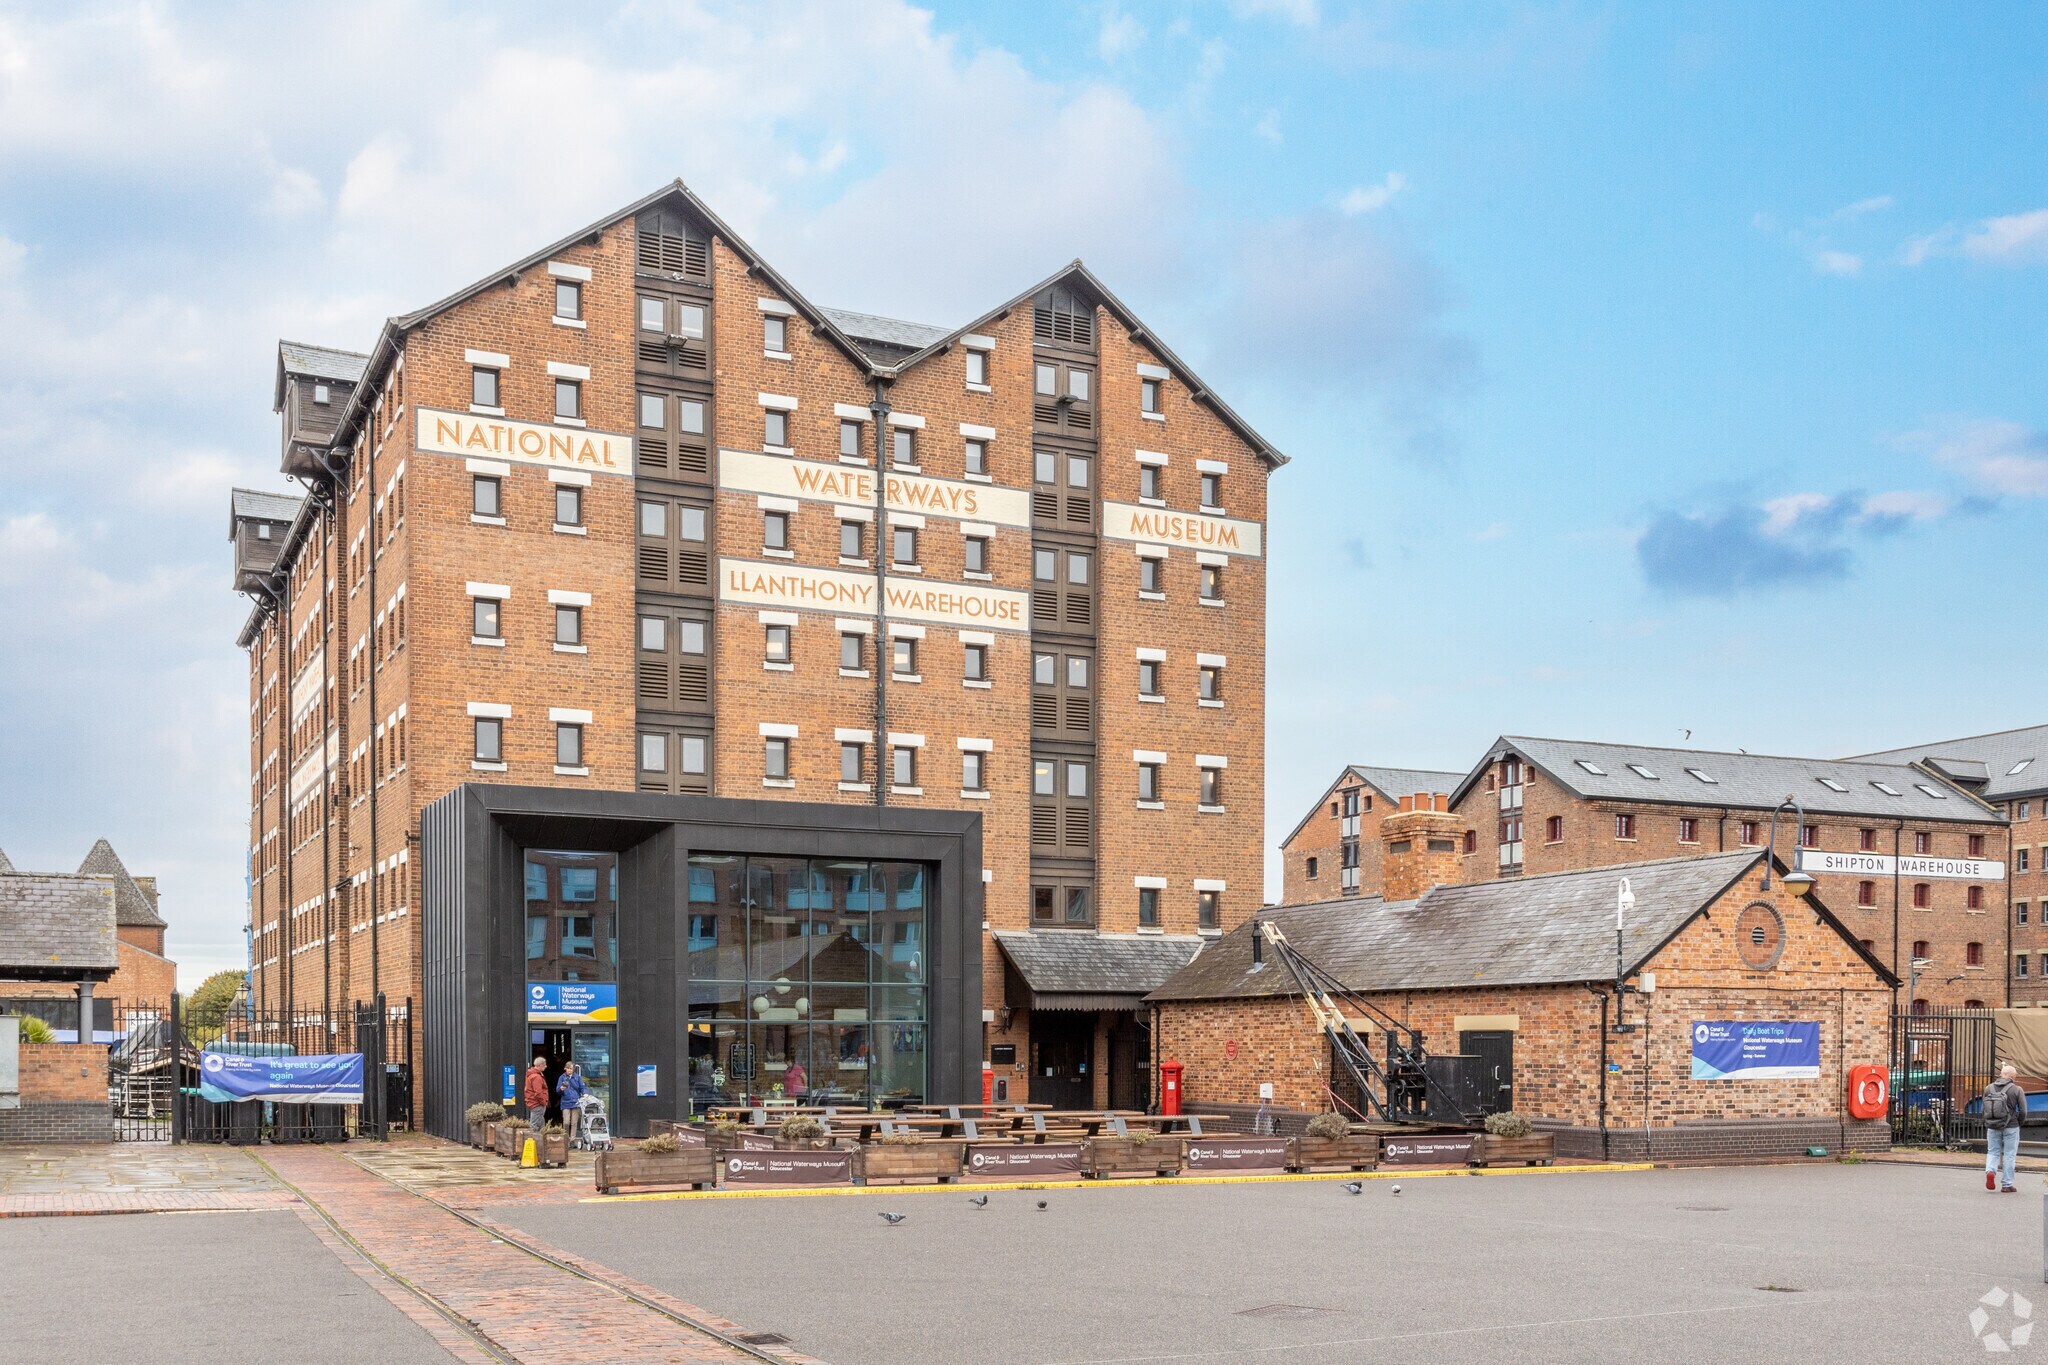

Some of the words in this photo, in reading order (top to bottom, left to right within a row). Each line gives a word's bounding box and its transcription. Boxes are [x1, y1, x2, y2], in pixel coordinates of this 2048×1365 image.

[437, 417, 616, 467] NATIONAL
[793, 465, 979, 515] WATERWAYS
[1130, 511, 1239, 548] MUSEUM
[730, 570, 873, 604] LLANTHONY
[885, 586, 1020, 621] WAREHOUSE
[1826, 856, 1884, 870] SHIPTON
[1900, 860, 1980, 875] WAREHOUSE
[1743, 1028, 1756, 1036] Daily
[1770, 1028, 1784, 1036] Trips
[270, 1072, 293, 1081] again
[284, 1062, 308, 1070] great
[338, 1062, 353, 1070] you
